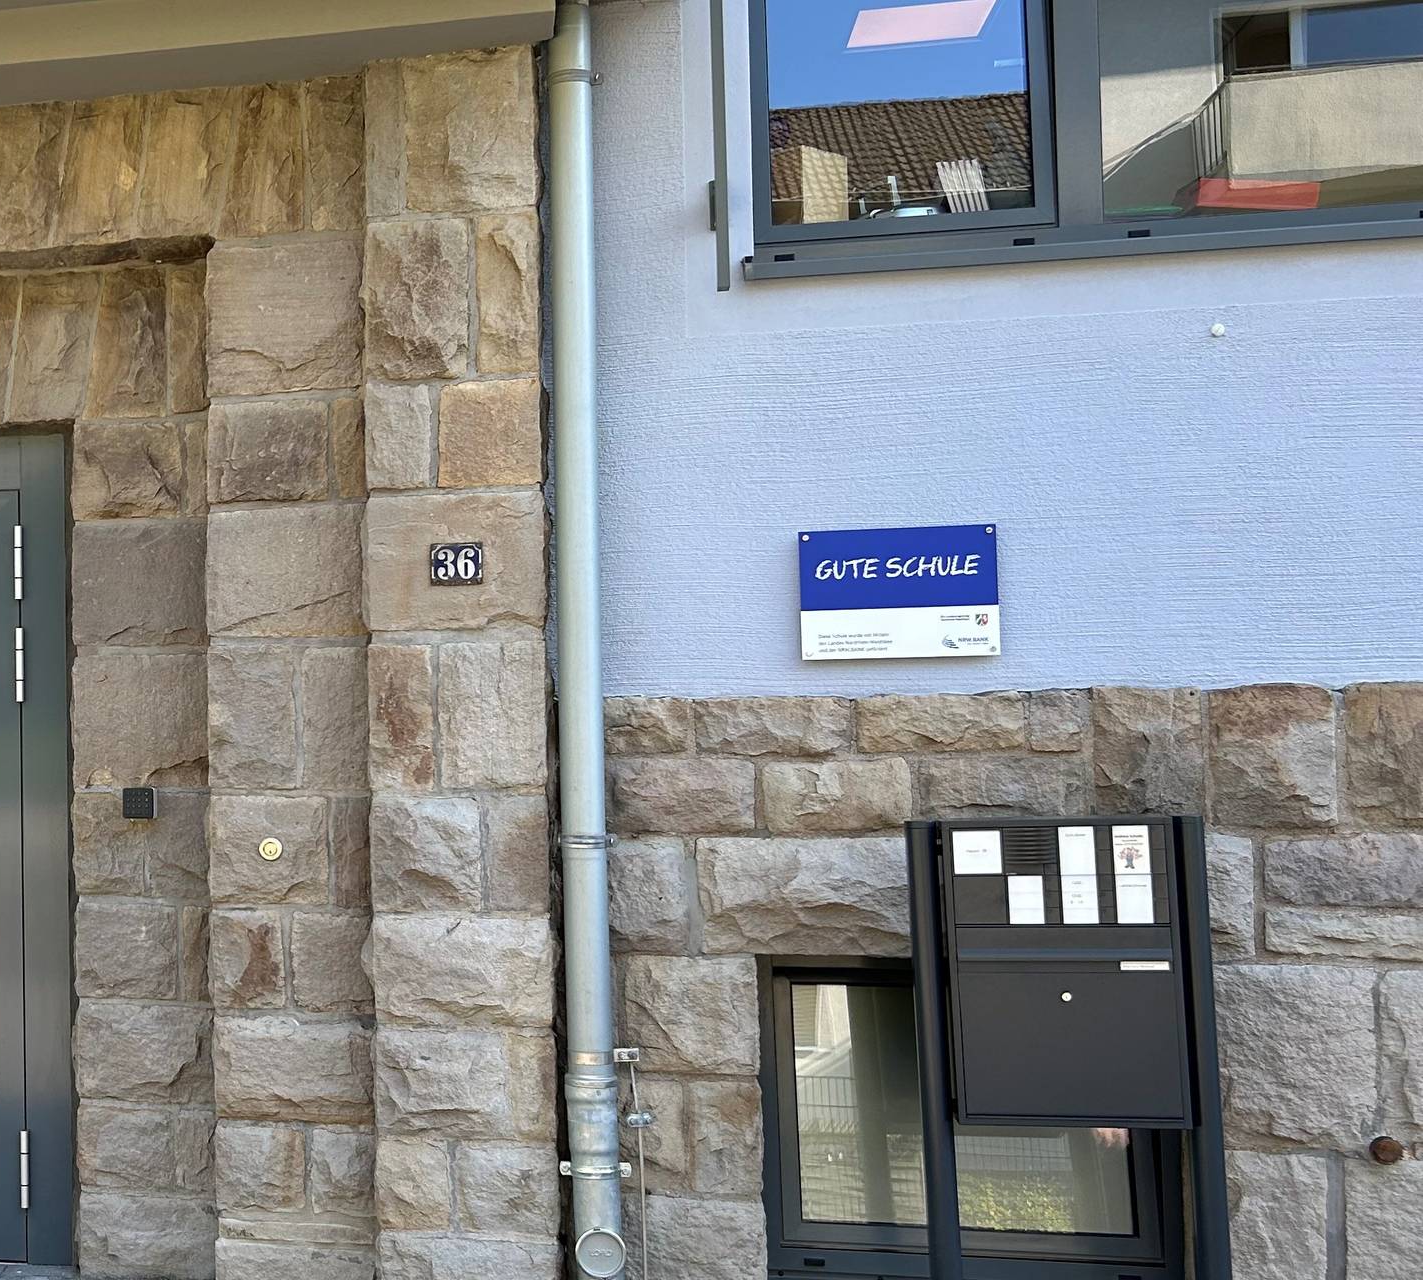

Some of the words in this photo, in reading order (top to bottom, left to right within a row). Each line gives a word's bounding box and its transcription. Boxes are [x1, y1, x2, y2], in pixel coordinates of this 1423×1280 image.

[437, 548, 476, 580] 36
[815, 558, 880, 580] GUTE
[885, 554, 981, 578] SCHULE
